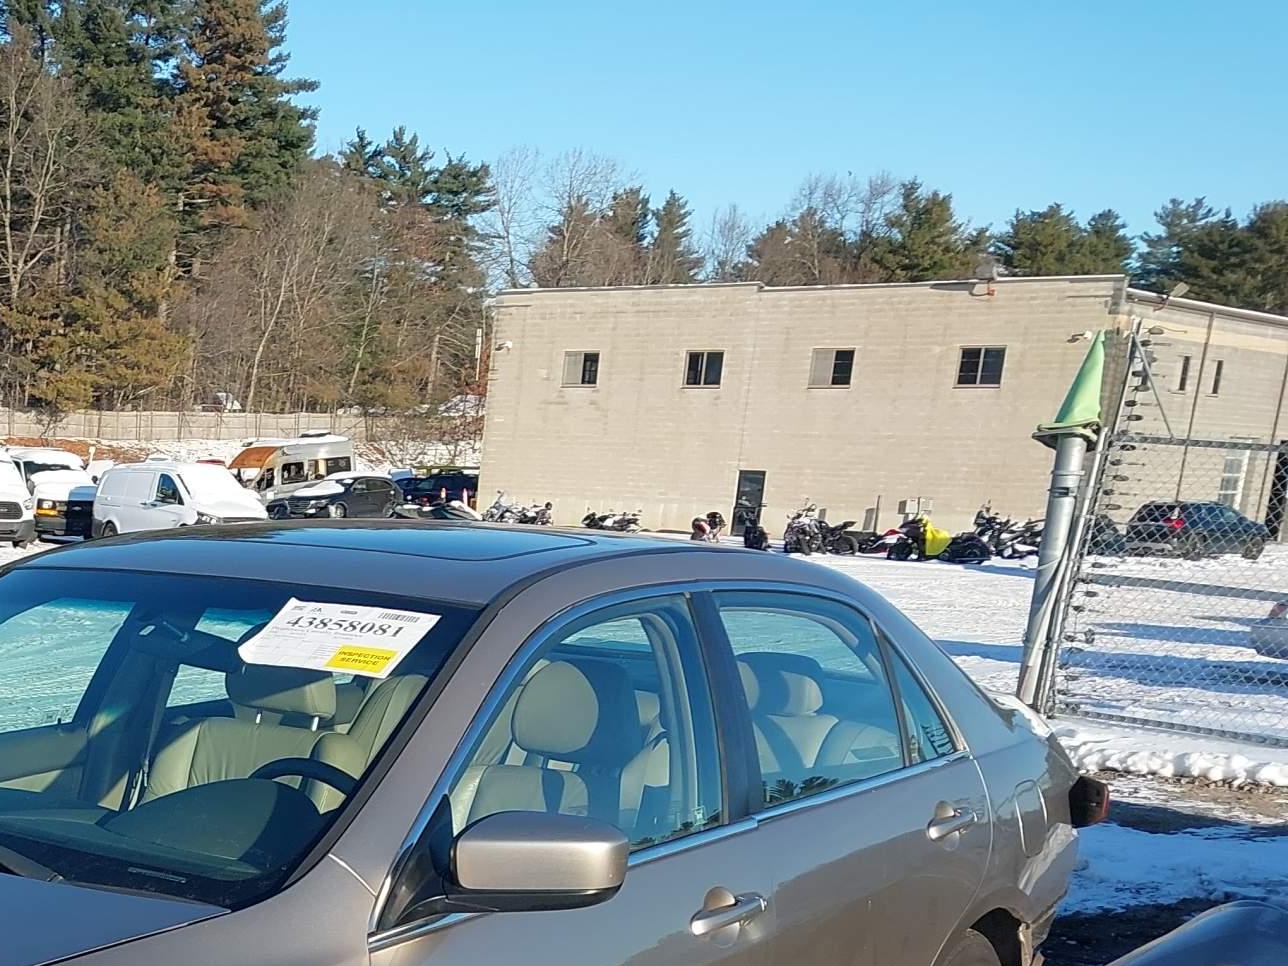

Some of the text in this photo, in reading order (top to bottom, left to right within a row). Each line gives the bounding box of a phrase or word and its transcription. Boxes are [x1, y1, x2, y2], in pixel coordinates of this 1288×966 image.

[287, 615, 404, 637] 43858081
[338, 650, 391, 661] INSPECTION
[340, 657, 380, 666] SERVICE
